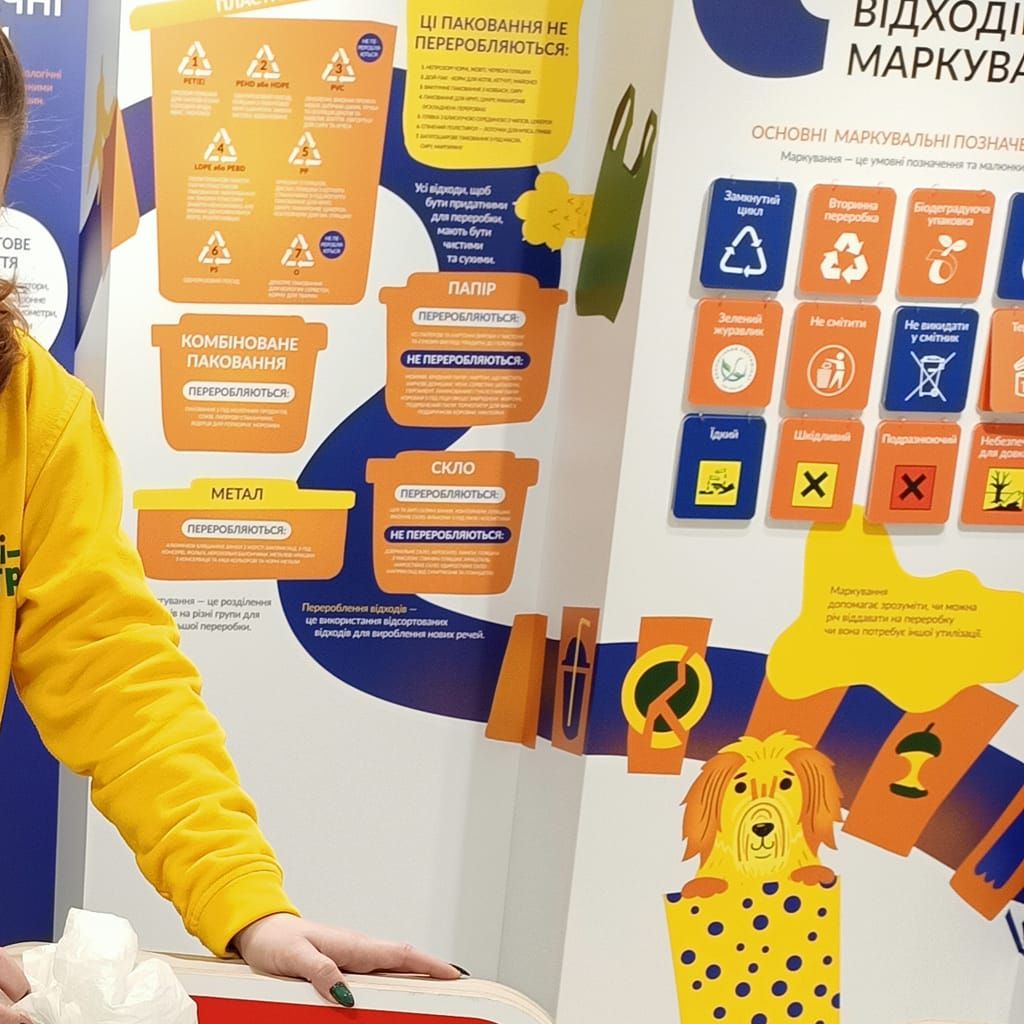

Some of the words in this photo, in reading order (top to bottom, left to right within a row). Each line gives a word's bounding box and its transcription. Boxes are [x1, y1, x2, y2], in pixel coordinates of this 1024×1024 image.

[420, 15, 437, 32] ЦІ
[441, 16, 543, 34] ПАКОВАННЯ
[547, 21, 569, 35] НЕ
[854, 0, 1024, 41] ВІДХОДІ
[415, 35, 569, 57] ПЕРЕРОБЛЯЮТЬСЯ:
[192, 56, 198, 67] 1
[260, 60, 268, 71] 2
[335, 63, 343, 74] 3
[331, 84, 344, 92] PVC
[752, 125, 827, 142] ОСНОВНІ
[834, 128, 950, 148] МАРКУВАЛЬНІ
[217, 143, 224, 153] 4
[302, 146, 309, 157] 5
[780, 151, 842, 164] Маркування
[856, 157, 869, 167] це
[871, 156, 904, 167] умовні
[907, 159, 964, 169] позначення
[966, 162, 976, 170] та
[415, 182, 428, 192] Усі
[470, 185, 491, 196] щоб
[425, 197, 448, 209] бути
[450, 200, 508, 210] придатними
[724, 190, 780, 206] Замкнутий
[829, 198, 878, 211] Вторинна
[914, 202, 991, 215] Біодеградуюча
[737, 206, 763, 217] цикл
[431, 213, 449, 223] для
[825, 212, 879, 224] переробка
[928, 217, 974, 227] упаковка
[437, 227, 468, 236] мають
[469, 226, 492, 237] бути
[212, 246, 218, 255] 6
[443, 241, 484, 250] чистими
[295, 248, 301, 258] 7
[447, 255, 457, 263] та
[448, 281, 496, 296] ПАПІР
[419, 311, 520, 323] ПЕРЕРОБЛЯЮТЬСЯ:
[718, 312, 762, 324] Зелений
[810, 316, 825, 327] Не
[827, 317, 867, 329] смітити
[713, 327, 764, 337] журавлик
[905, 320, 919, 330] Не
[921, 322, 969, 332] викидати
[181, 334, 299, 351] КОМБІНОВАНЕ
[911, 334, 917, 344] у
[919, 332, 959, 343] смітник
[187, 354, 286, 370] ПАКОВАННЯ
[407, 354, 422, 364] НЕ
[423, 355, 523, 366] ПЕРЕРОБЛЯЮТЬСЯ:
[189, 386, 290, 398] ПЕРЕРОБЛЯЮТЬСЯ:
[710, 426, 739, 441] Їдкий
[794, 430, 851, 442] Шкідливий
[882, 433, 957, 445] Подразнюючий
[432, 461, 476, 475] СКЛО
[212, 488, 263, 500] МЕТАЛ
[401, 489, 499, 499] ПЕРЕРОБЛЯЮТЬСЯ:
[187, 524, 287, 535] ПЕРЕРОБЛЯЮТЬСЯ:
[390, 530, 404, 539] НЕ
[406, 530, 504, 540] ПЕРЕРОБЛЯЮТЬСЯ:
[207, 598, 218, 606] це
[221, 596, 271, 607] розділення
[302, 603, 368, 613] Перероблення
[370, 604, 407, 614] відходів
[193, 609, 212, 620] різні
[215, 611, 241, 621] групи
[243, 611, 260, 619] для
[305, 618, 317, 626] це
[319, 617, 381, 626] використання
[383, 617, 448, 627] відсортованих
[314, 628, 351, 638] відходів
[353, 630, 370, 638] для
[372, 629, 426, 640] вироблення
